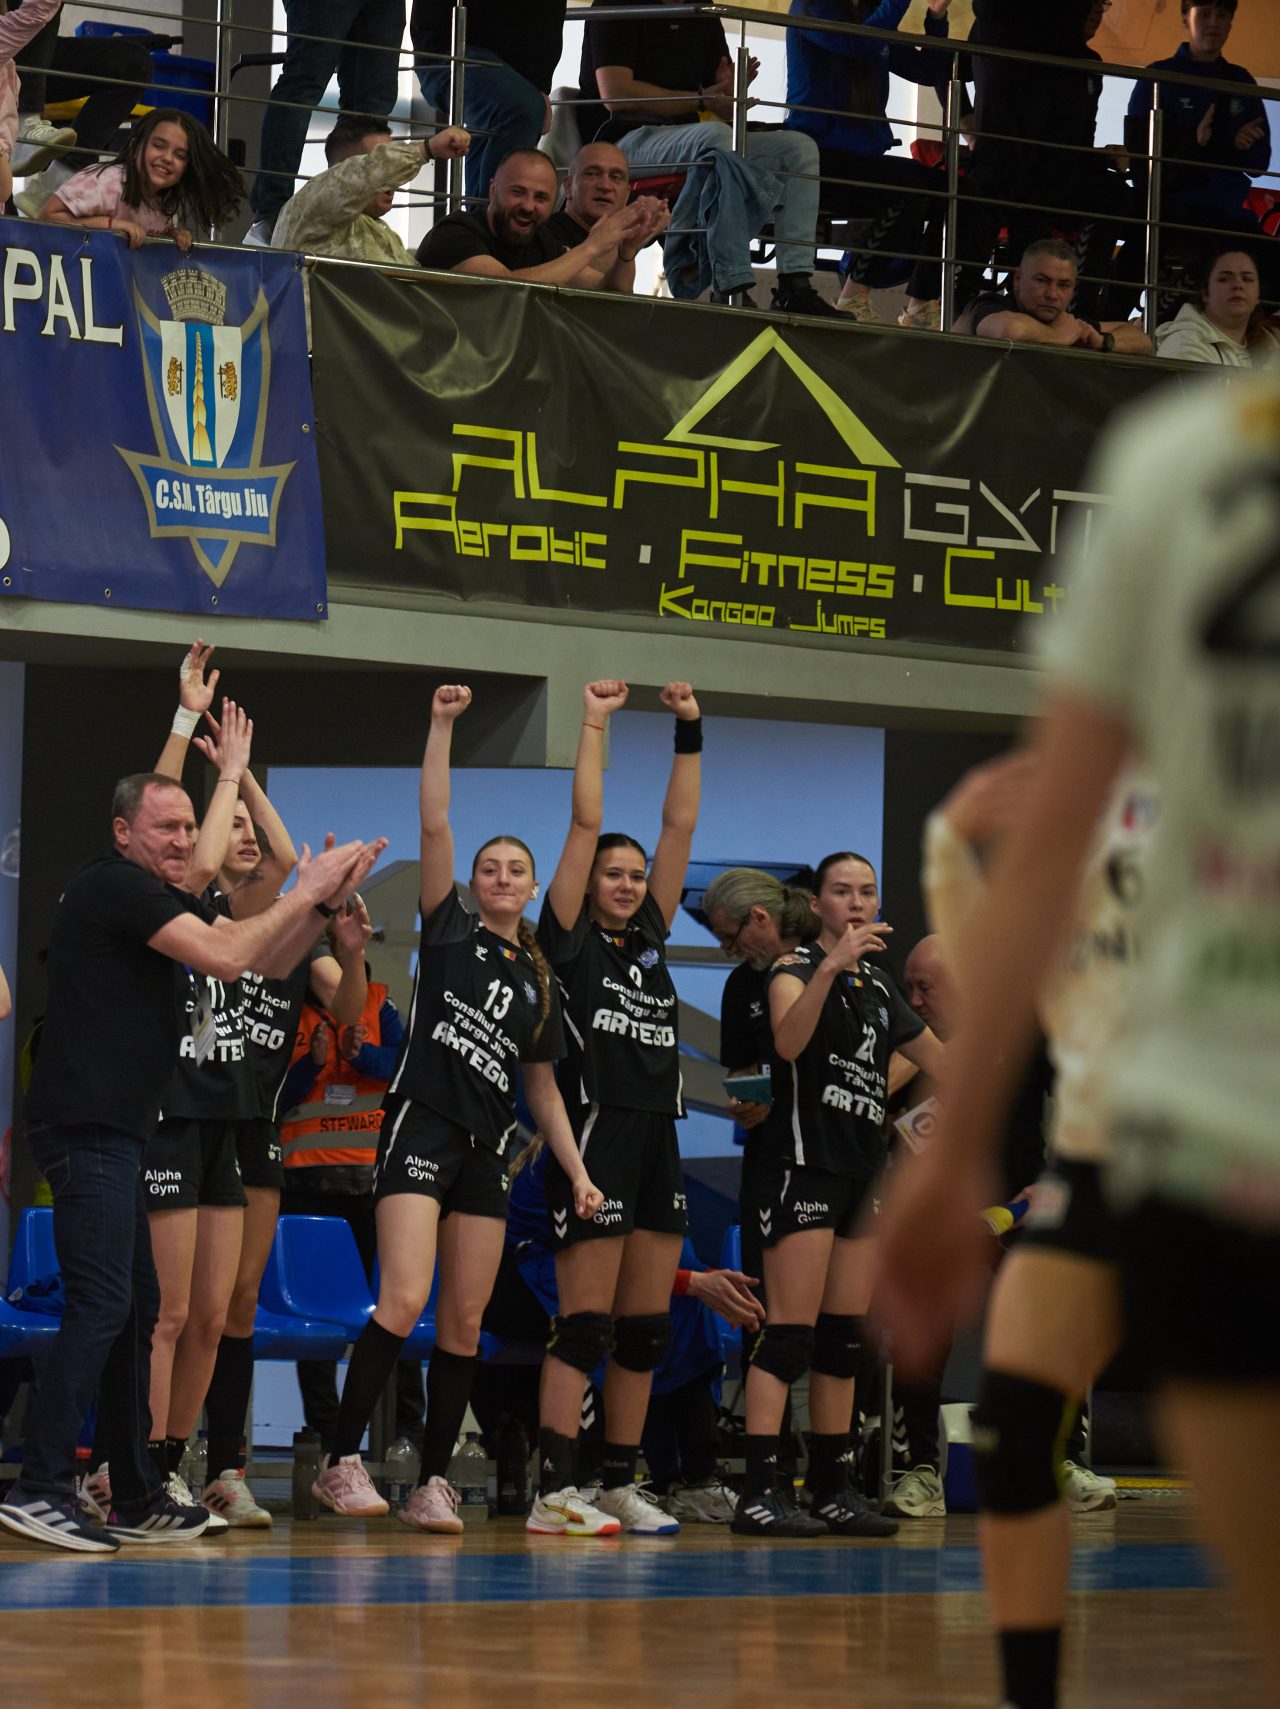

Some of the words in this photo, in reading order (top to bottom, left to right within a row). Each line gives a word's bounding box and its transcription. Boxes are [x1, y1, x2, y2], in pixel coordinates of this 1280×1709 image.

[452, 423, 877, 537] ALPHA
[155, 478, 196, 513] C.S.M.
[195, 484, 242, 519] Târgu
[244, 488, 269, 517] Jiu
[678, 528, 896, 599] Fitness
[483, 978, 514, 1020] 13
[602, 976, 655, 1006] Consiliul
[618, 993, 651, 1018] Târgu
[443, 990, 496, 1034] Consiliul
[592, 1008, 676, 1048] ARTEGO
[454, 1011, 490, 1044] Târgu
[490, 1040, 506, 1060] Jiu
[431, 1020, 509, 1093] ARTEGO
[144, 1169, 182, 1184] Alpha
[404, 1154, 440, 1172] Alpha
[407, 1166, 435, 1182] Gym
[149, 1182, 180, 1196] Gym
[593, 1211, 622, 1225] Gym
[793, 1200, 829, 1214] Alpha
